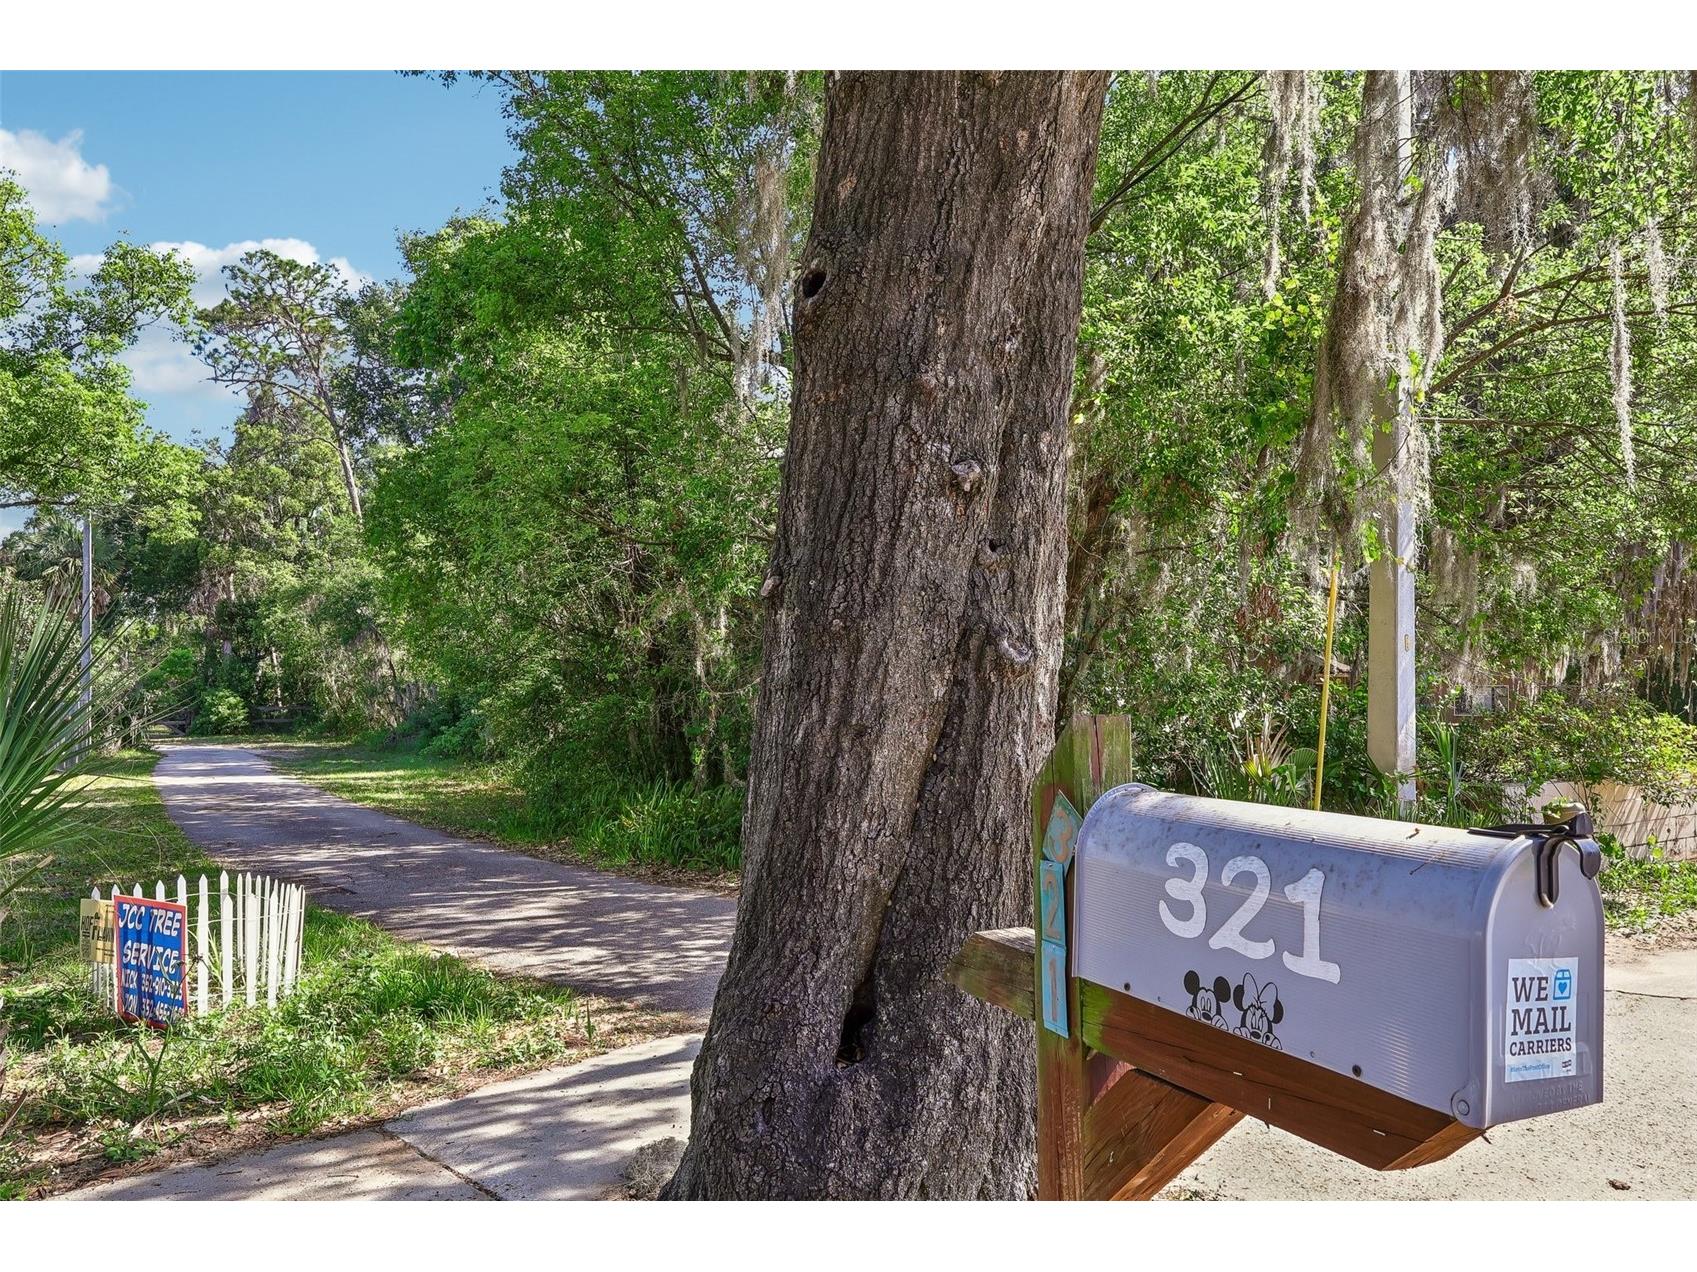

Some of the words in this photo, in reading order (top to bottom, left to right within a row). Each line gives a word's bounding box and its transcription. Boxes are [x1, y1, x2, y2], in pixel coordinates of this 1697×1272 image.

[118, 903, 145, 931] JCC
[149, 909, 182, 937] TREE
[1159, 842, 1341, 984] 321
[122, 940, 179, 974] SERVICE
[1512, 976, 1549, 1002] WE
[1510, 1006, 1571, 1036] MAIL
[1509, 1037, 1572, 1056] CARRIERS
